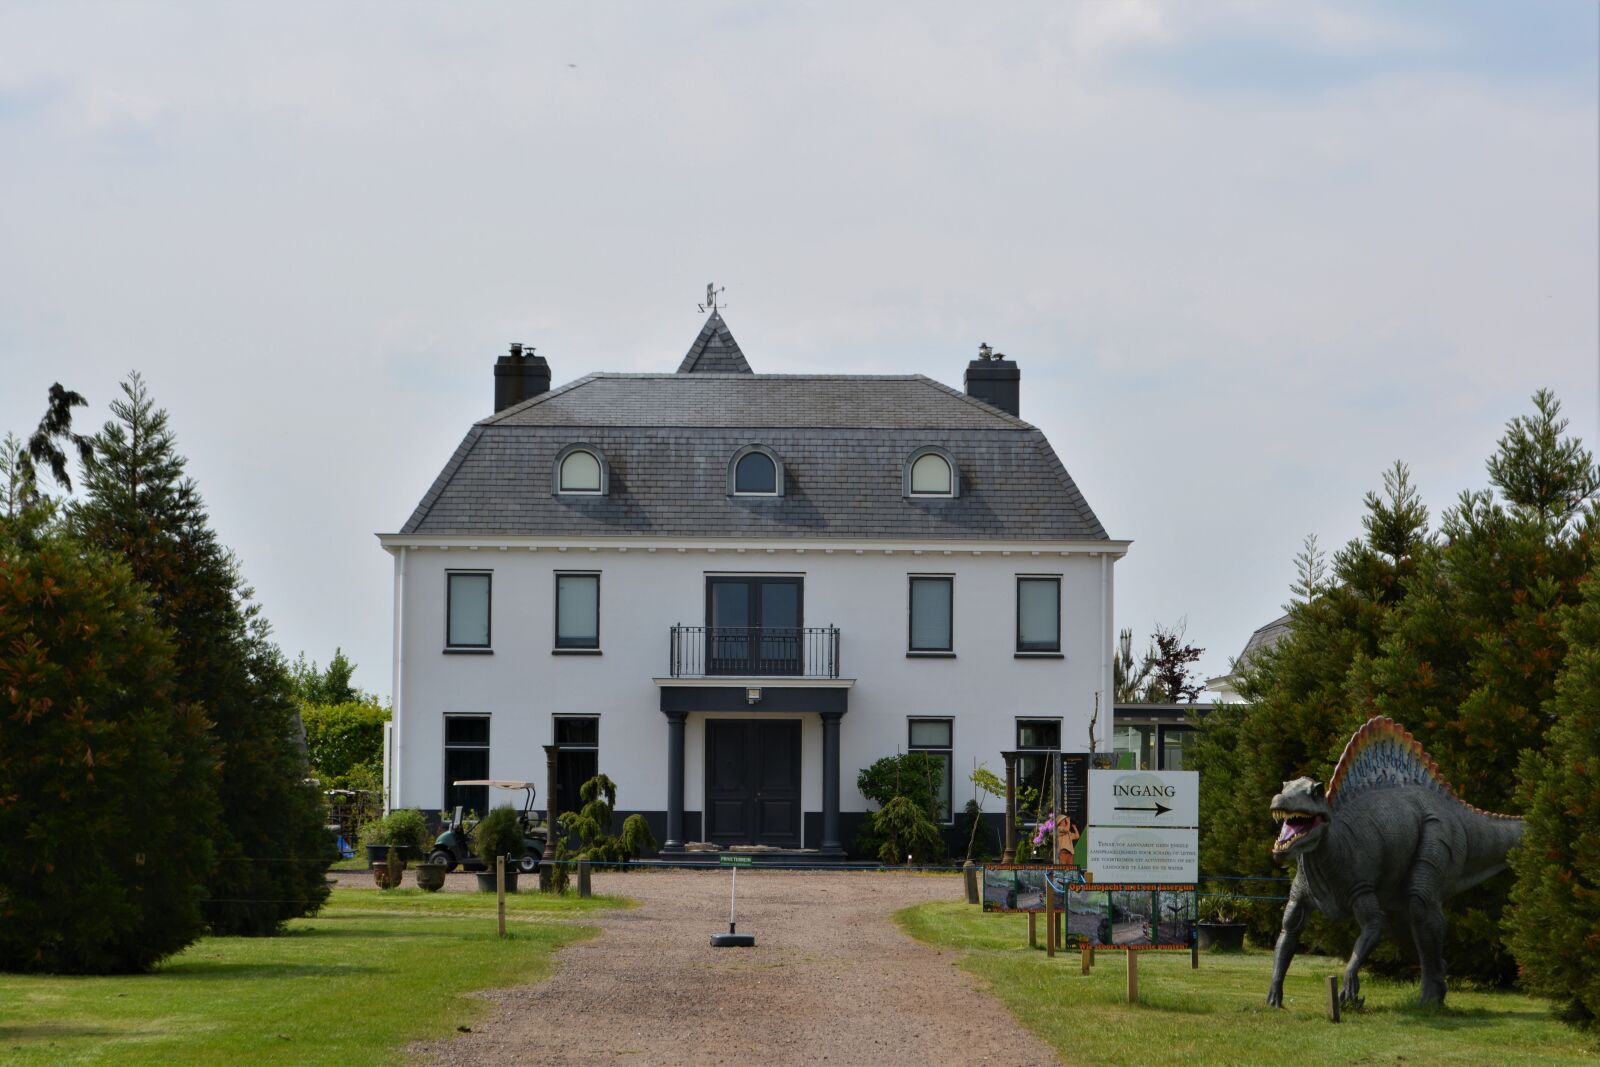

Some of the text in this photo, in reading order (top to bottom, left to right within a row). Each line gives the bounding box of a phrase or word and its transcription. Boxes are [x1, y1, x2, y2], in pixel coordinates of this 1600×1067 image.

[1113, 784, 1176, 797] INGANG
[1069, 882, 1080, 892] Op
[1082, 882, 1122, 892] dinojacht
[1158, 883, 1195, 892] lasergun
